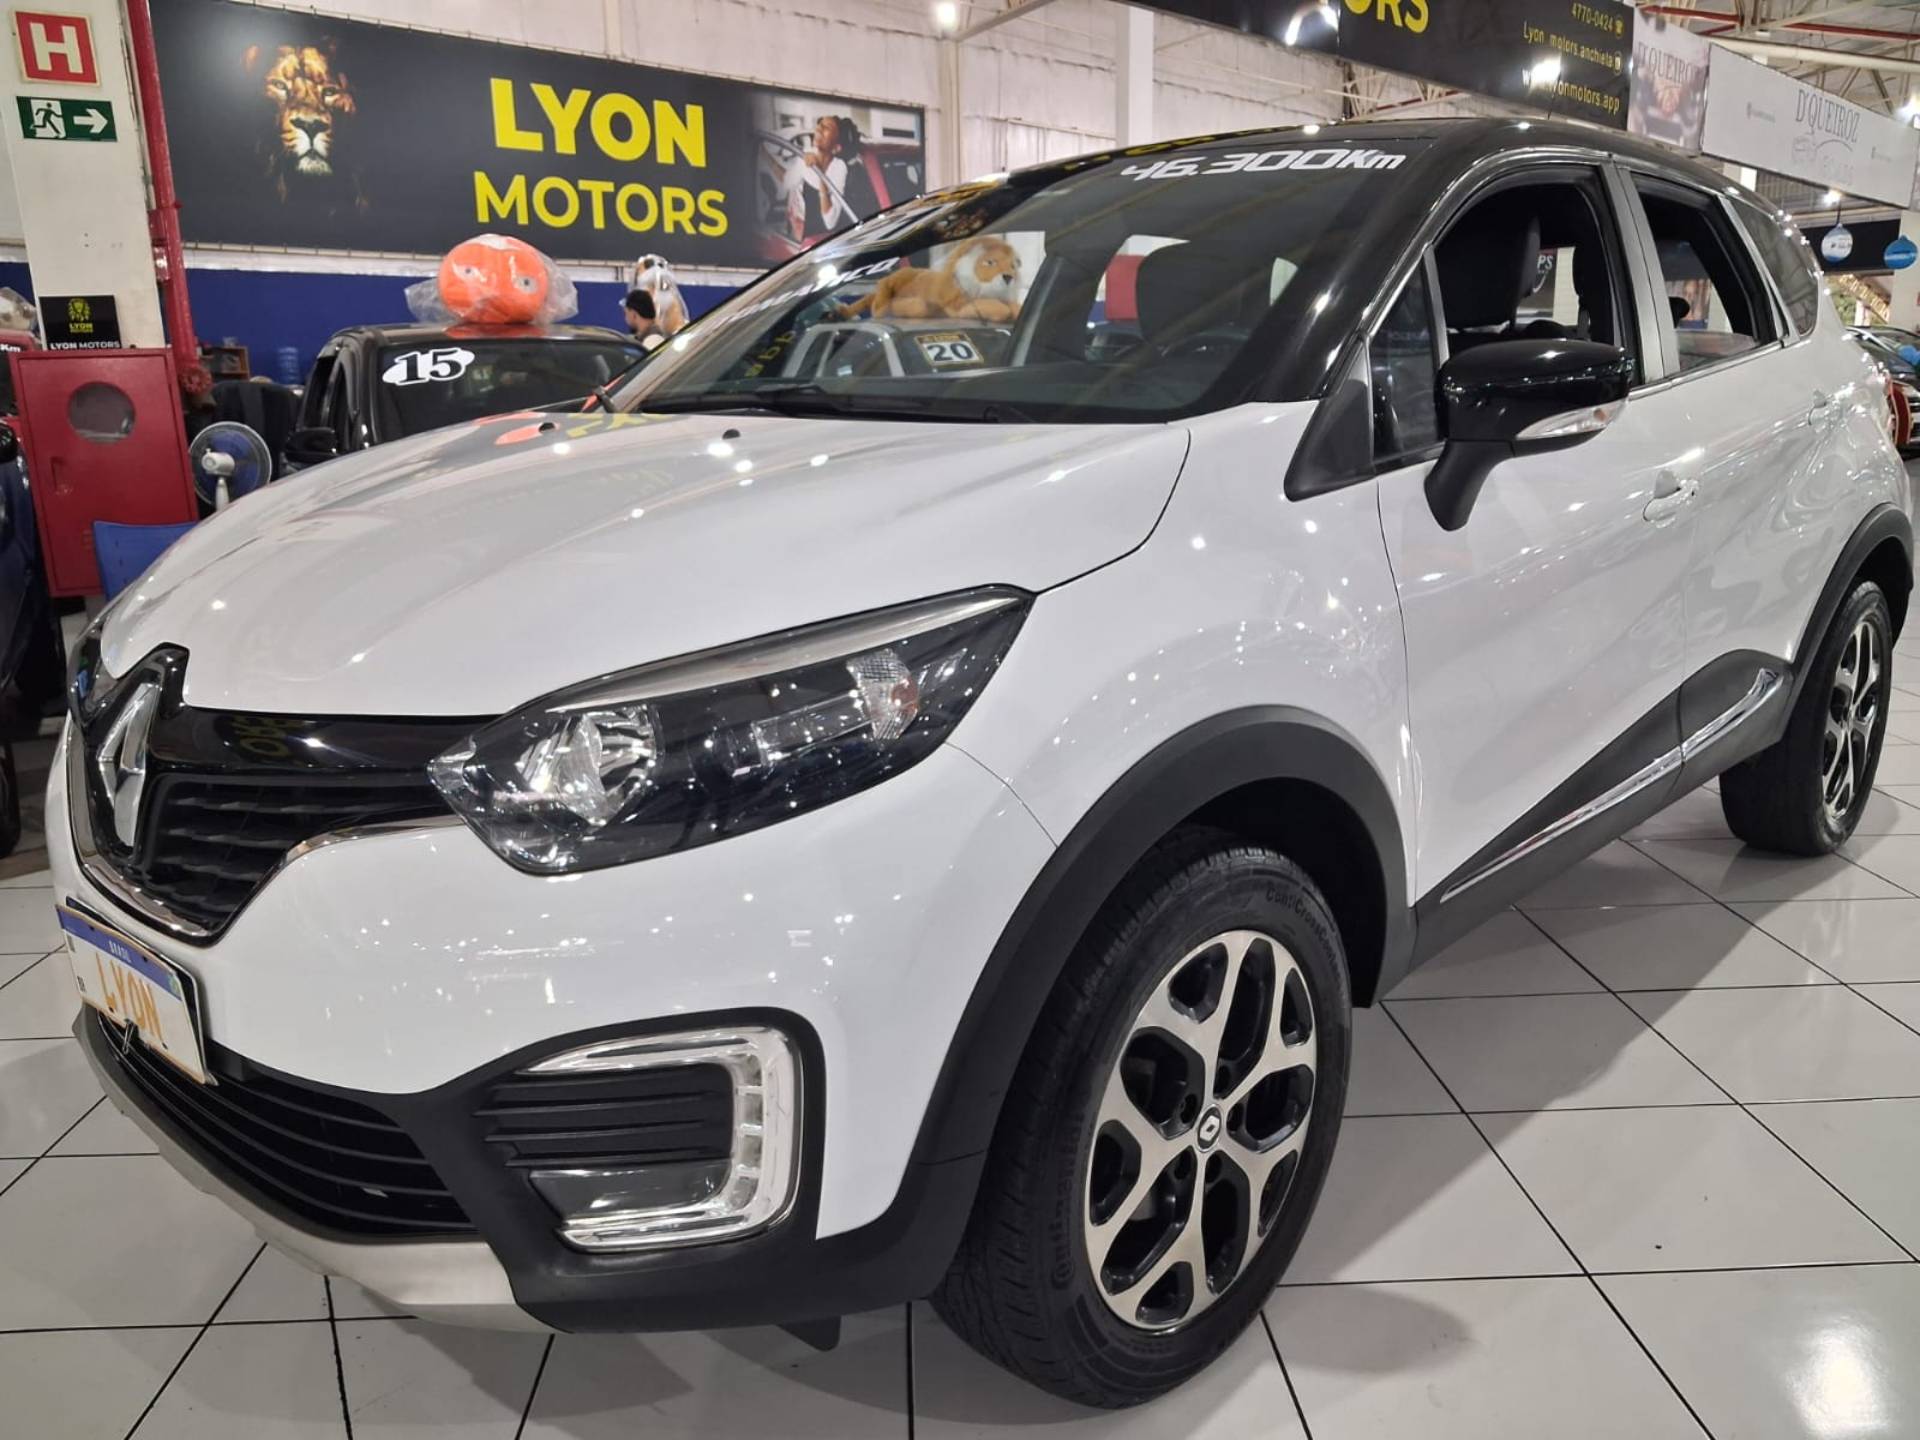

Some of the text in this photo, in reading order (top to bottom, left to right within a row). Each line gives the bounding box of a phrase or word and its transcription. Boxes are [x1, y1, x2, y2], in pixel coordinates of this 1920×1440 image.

[1523, 20, 1545, 45] Lyon
[1571, 2, 1614, 31] 4770-0424
[29, 22, 84, 74] H
[490, 77, 706, 168] LYON
[1120, 149, 1406, 181] 46.300Km
[473, 170, 728, 237] MOTORS
[50, 340, 120, 350] LYON MOTORS
[927, 342, 974, 361] 20
[395, 349, 465, 384] 15
[95, 951, 164, 1046] LYON
